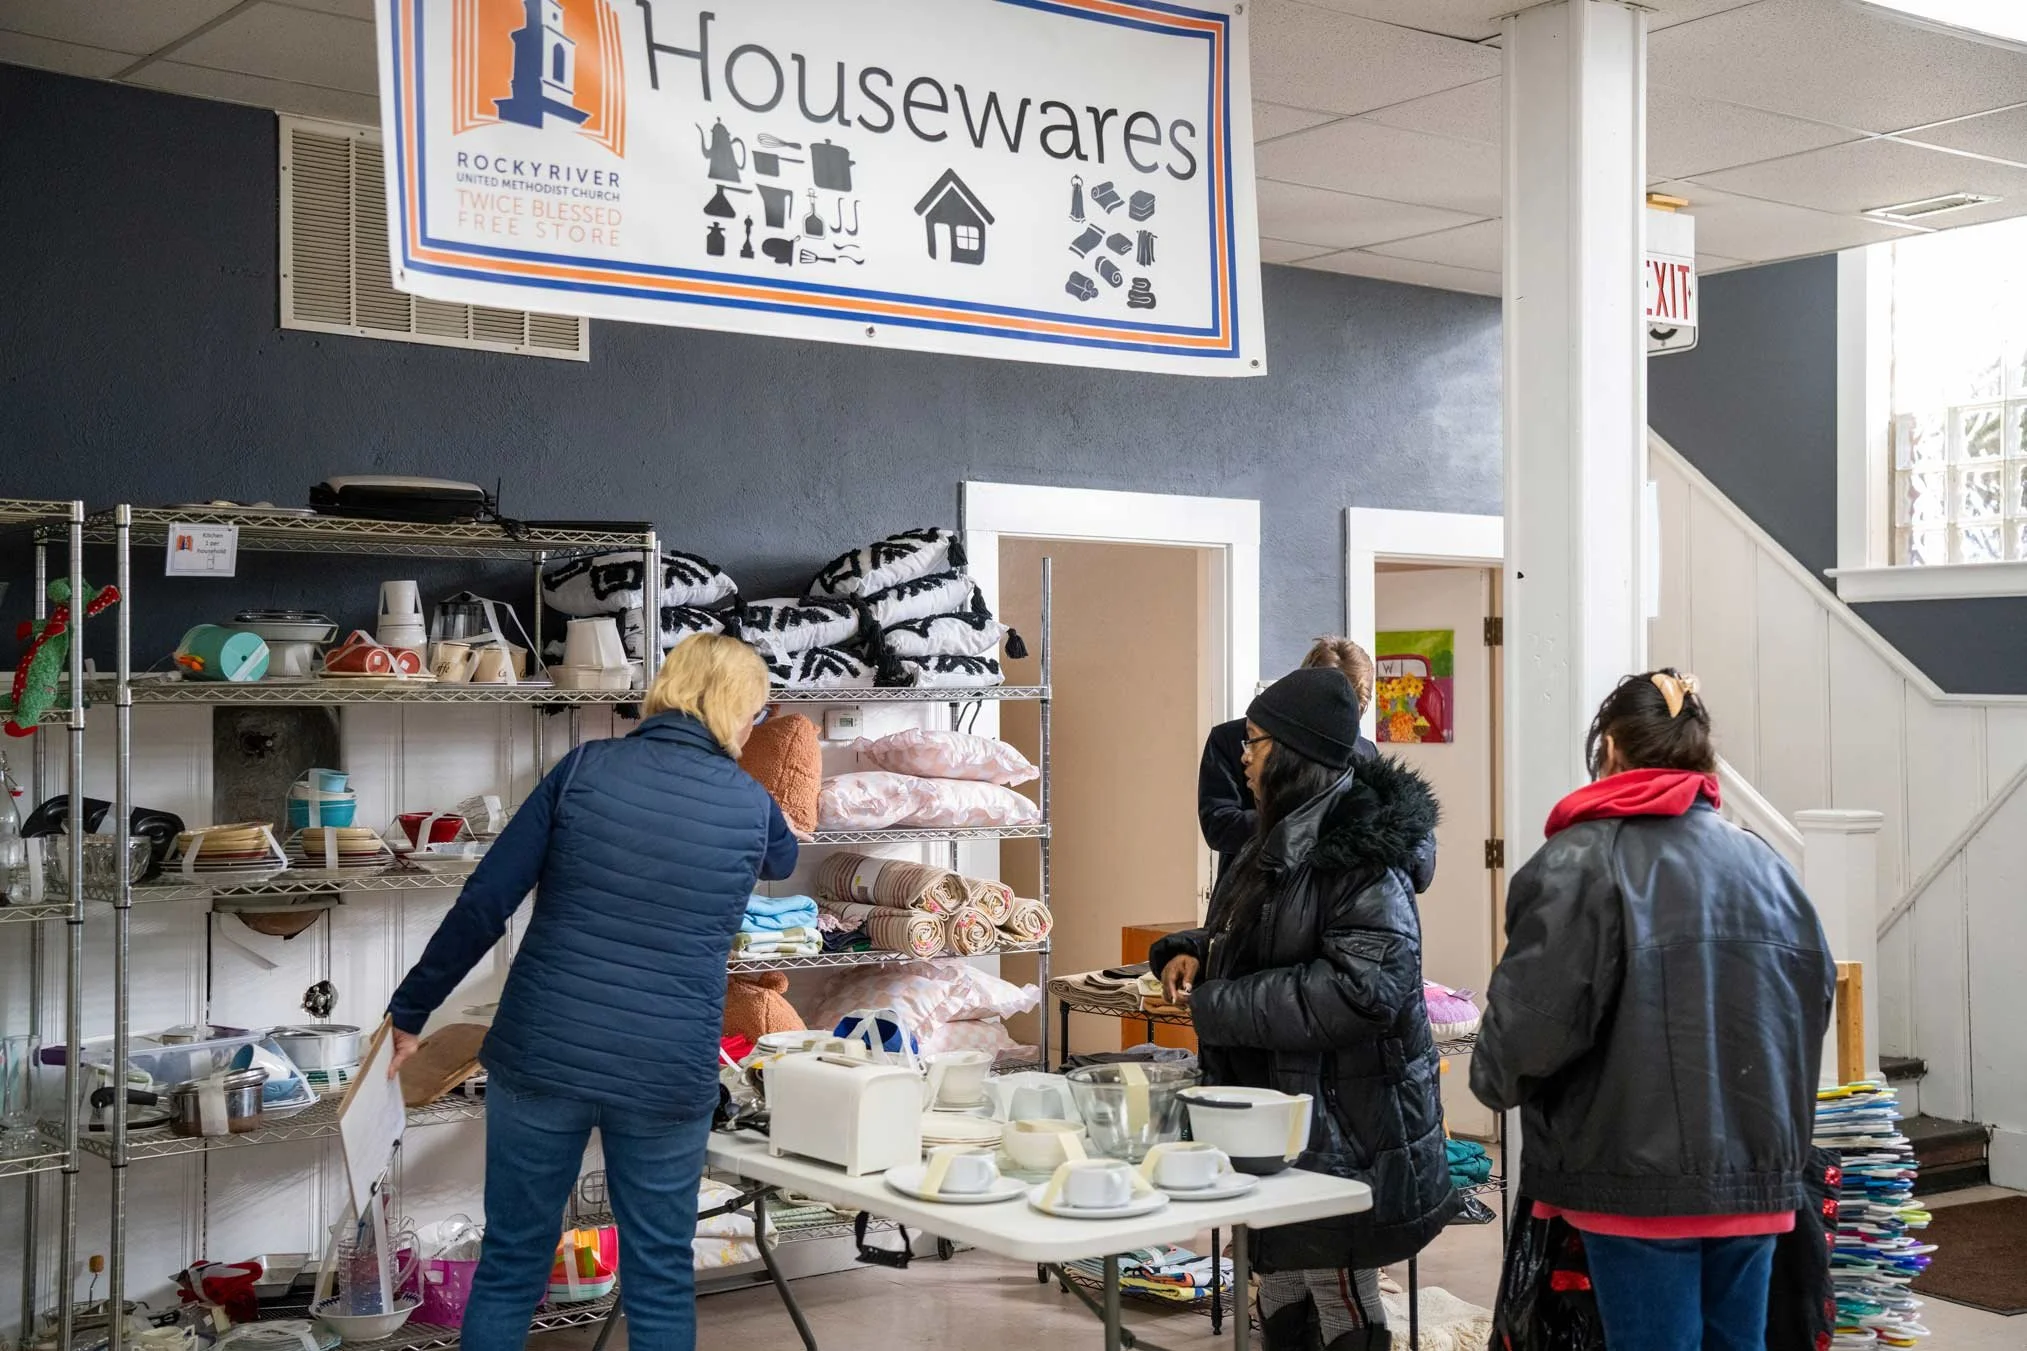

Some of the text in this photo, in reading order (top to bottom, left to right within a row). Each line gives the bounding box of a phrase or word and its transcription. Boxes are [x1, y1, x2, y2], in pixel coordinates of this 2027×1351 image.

[635, 0, 1198, 182] Housewares
[456, 172, 621, 202] UNITED METHODIST CHURCH
[456, 188, 623, 227] TWICE BLESSED
[458, 211, 620, 247] FREE STORE
